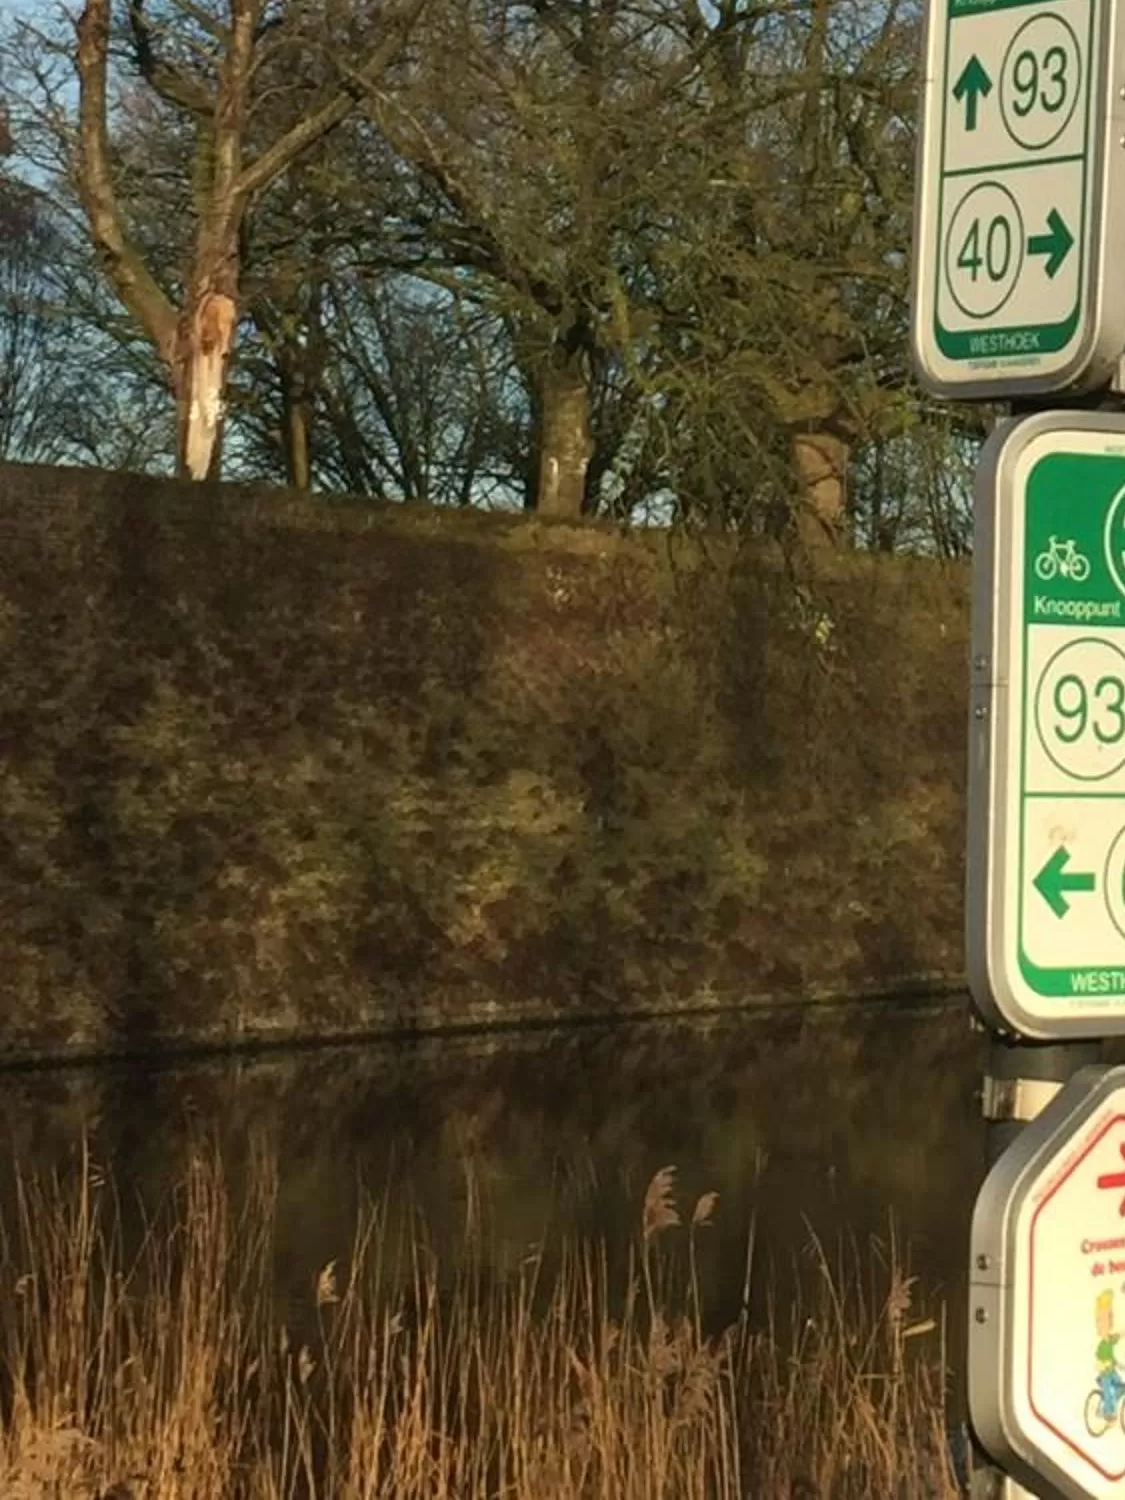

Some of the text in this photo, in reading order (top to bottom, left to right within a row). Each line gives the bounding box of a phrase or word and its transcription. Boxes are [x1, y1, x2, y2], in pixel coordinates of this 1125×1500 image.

[1011, 46, 1068, 117] 93
[956, 214, 1012, 284] 40
[969, 332, 1041, 355] WESTHOEK
[1034, 594, 1121, 620] Knooppunt
